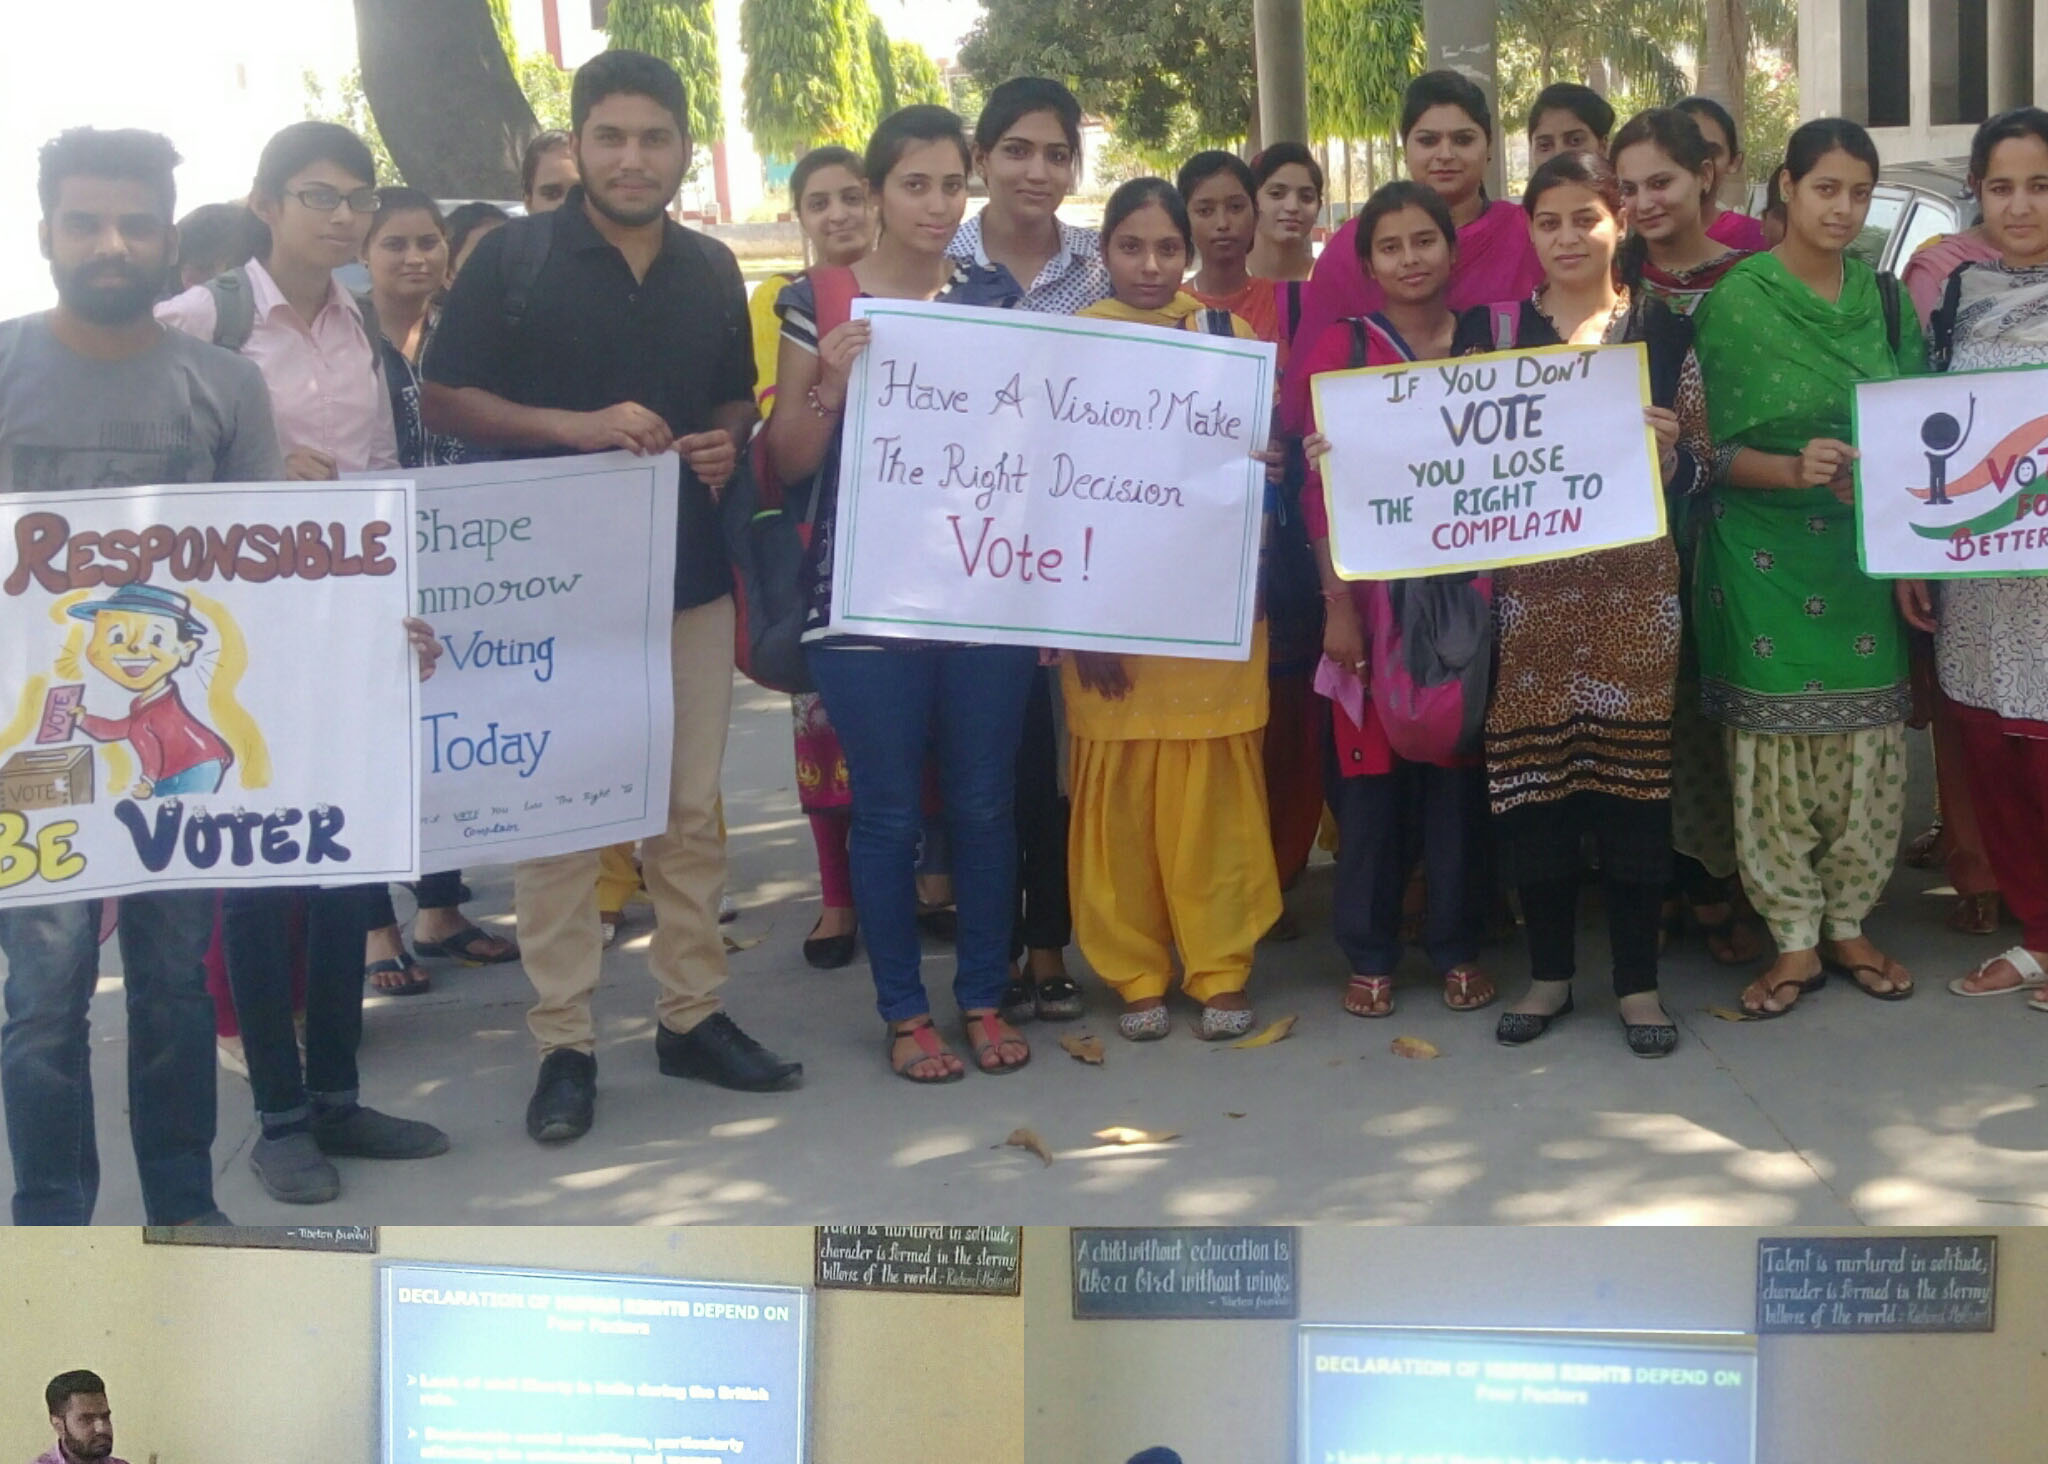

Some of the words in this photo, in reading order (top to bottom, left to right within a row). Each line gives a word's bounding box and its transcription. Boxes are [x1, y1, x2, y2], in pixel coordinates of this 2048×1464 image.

[878, 360, 968, 413] Have
[990, 373, 1024, 419] A
[1440, 394, 1547, 447] VOTE
[872, 436, 924, 485] The
[938, 442, 1028, 510] Right
[1049, 453, 1185, 508] Decision
[1409, 458, 1465, 487] YOU
[1493, 445, 1565, 480] LOSE
[1369, 496, 1414, 525] THE
[1453, 480, 1538, 517] RIGHT
[1563, 473, 1603, 501] TO
[1431, 507, 1583, 551] COMPLAIN
[3, 512, 397, 596] RESPONSIBLE
[440, 631, 556, 683] Voting
[46, 692, 71, 739] VOTE
[421, 712, 552, 779] Today
[8, 782, 57, 803] VOTE
[0, 808, 87, 891] BE
[114, 799, 351, 872] VOTER
[955, 1245, 972, 1265] the
[1092, 1239, 1127, 1262] child
[1128, 1238, 1182, 1262] without
[1190, 1238, 1269, 1262] education
[1763, 1246, 1813, 1273] Talent
[1817, 1254, 1828, 1272] is
[1836, 1246, 1904, 1273] nurtured
[1911, 1253, 1926, 1273] in
[863, 1263, 877, 1286] of
[882, 1263, 899, 1283] the
[1114, 1273, 1127, 1293] a
[1182, 1268, 1241, 1293] without
[1917, 1277, 1935, 1300] the
[398, 1287, 523, 1308] DECLARATION
[693, 1303, 760, 1320] DEPEND
[764, 1306, 789, 1321] ON
[1315, 1355, 1450, 1376] DECLARATION
[1635, 1368, 1708, 1386] DEPEND
[1714, 1370, 1742, 1386] ON
